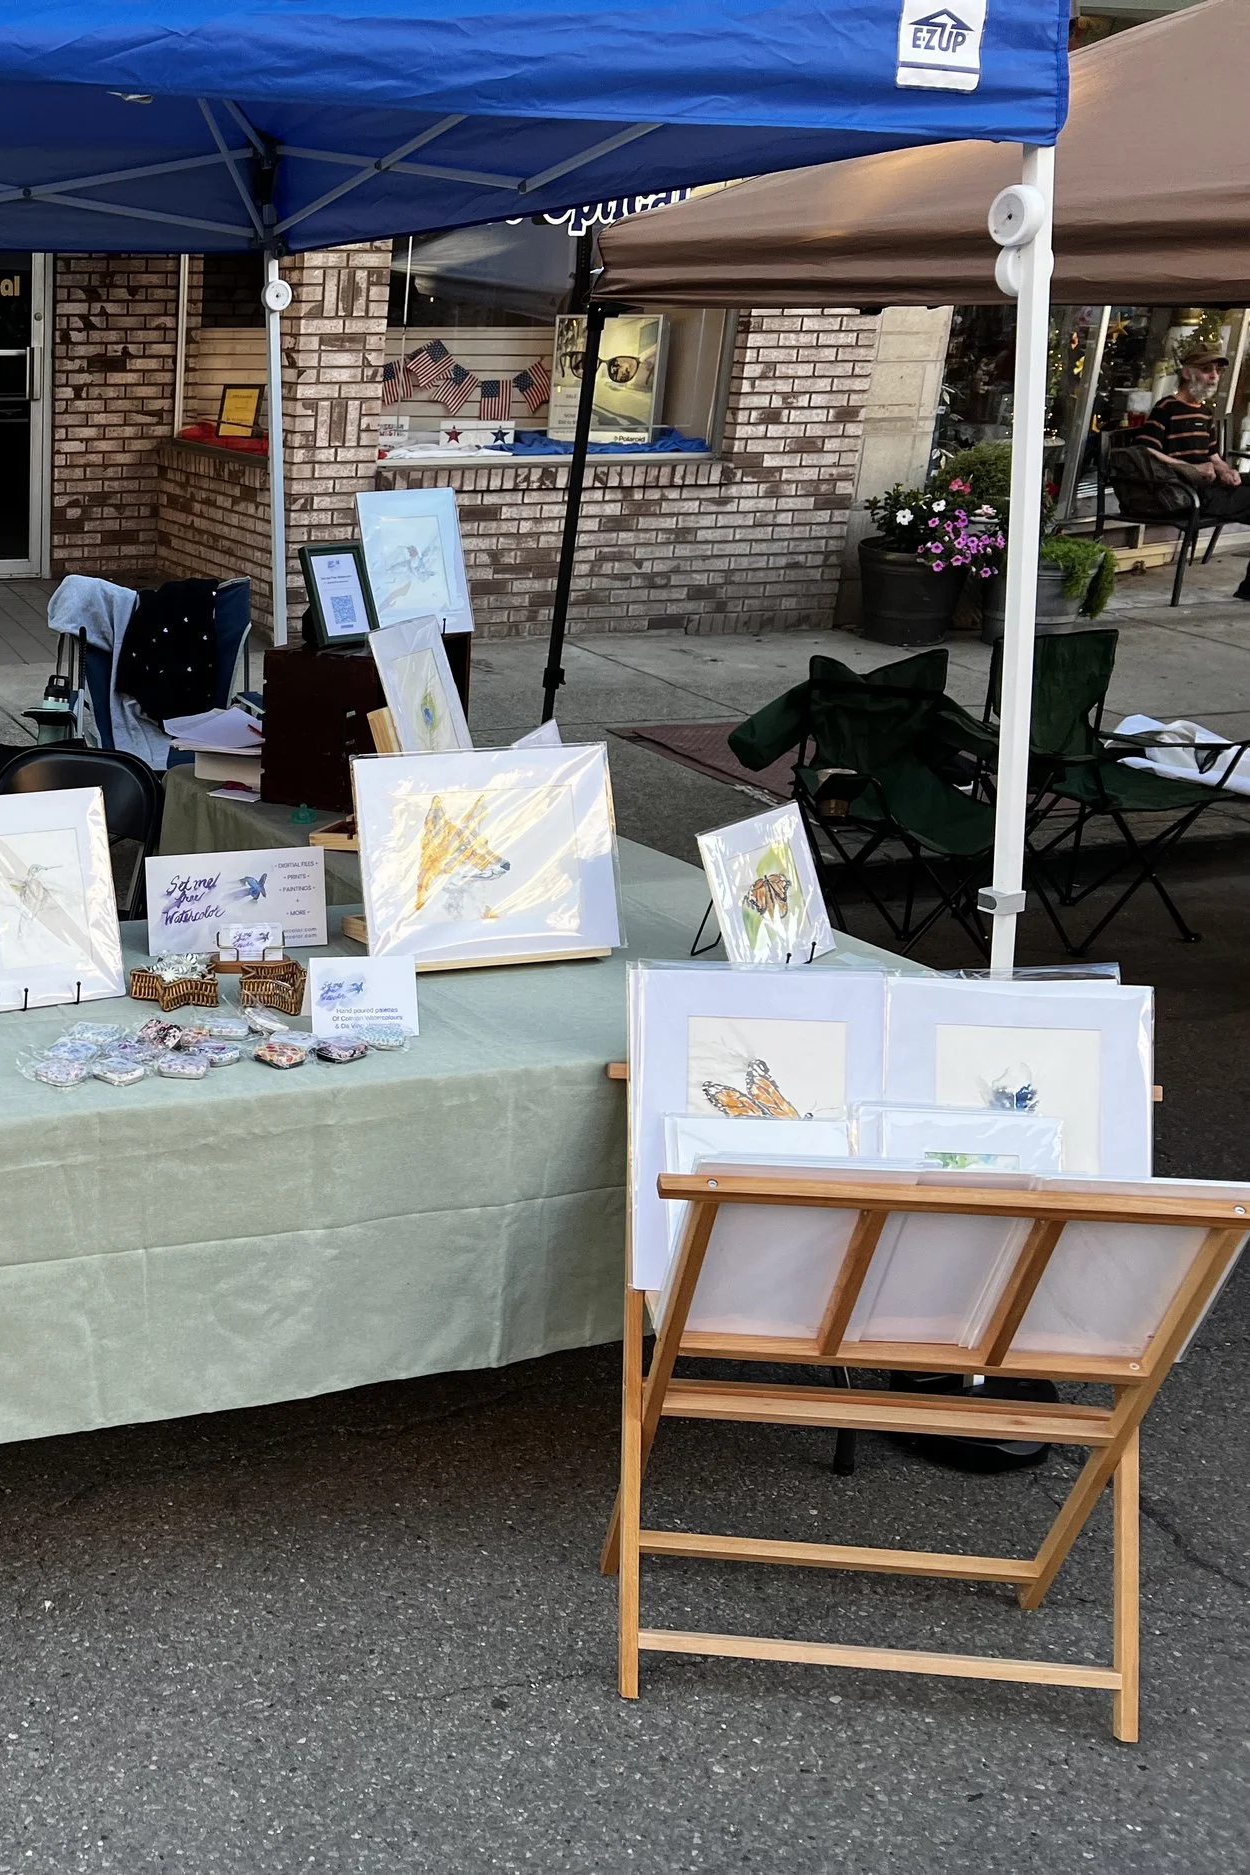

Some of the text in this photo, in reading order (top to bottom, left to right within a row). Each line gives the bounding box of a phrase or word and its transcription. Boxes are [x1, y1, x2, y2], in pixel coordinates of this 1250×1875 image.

[618, 435, 646, 443] Polaroid
[165, 874, 192, 896] Set
[161, 904, 226, 926] Watercolor
